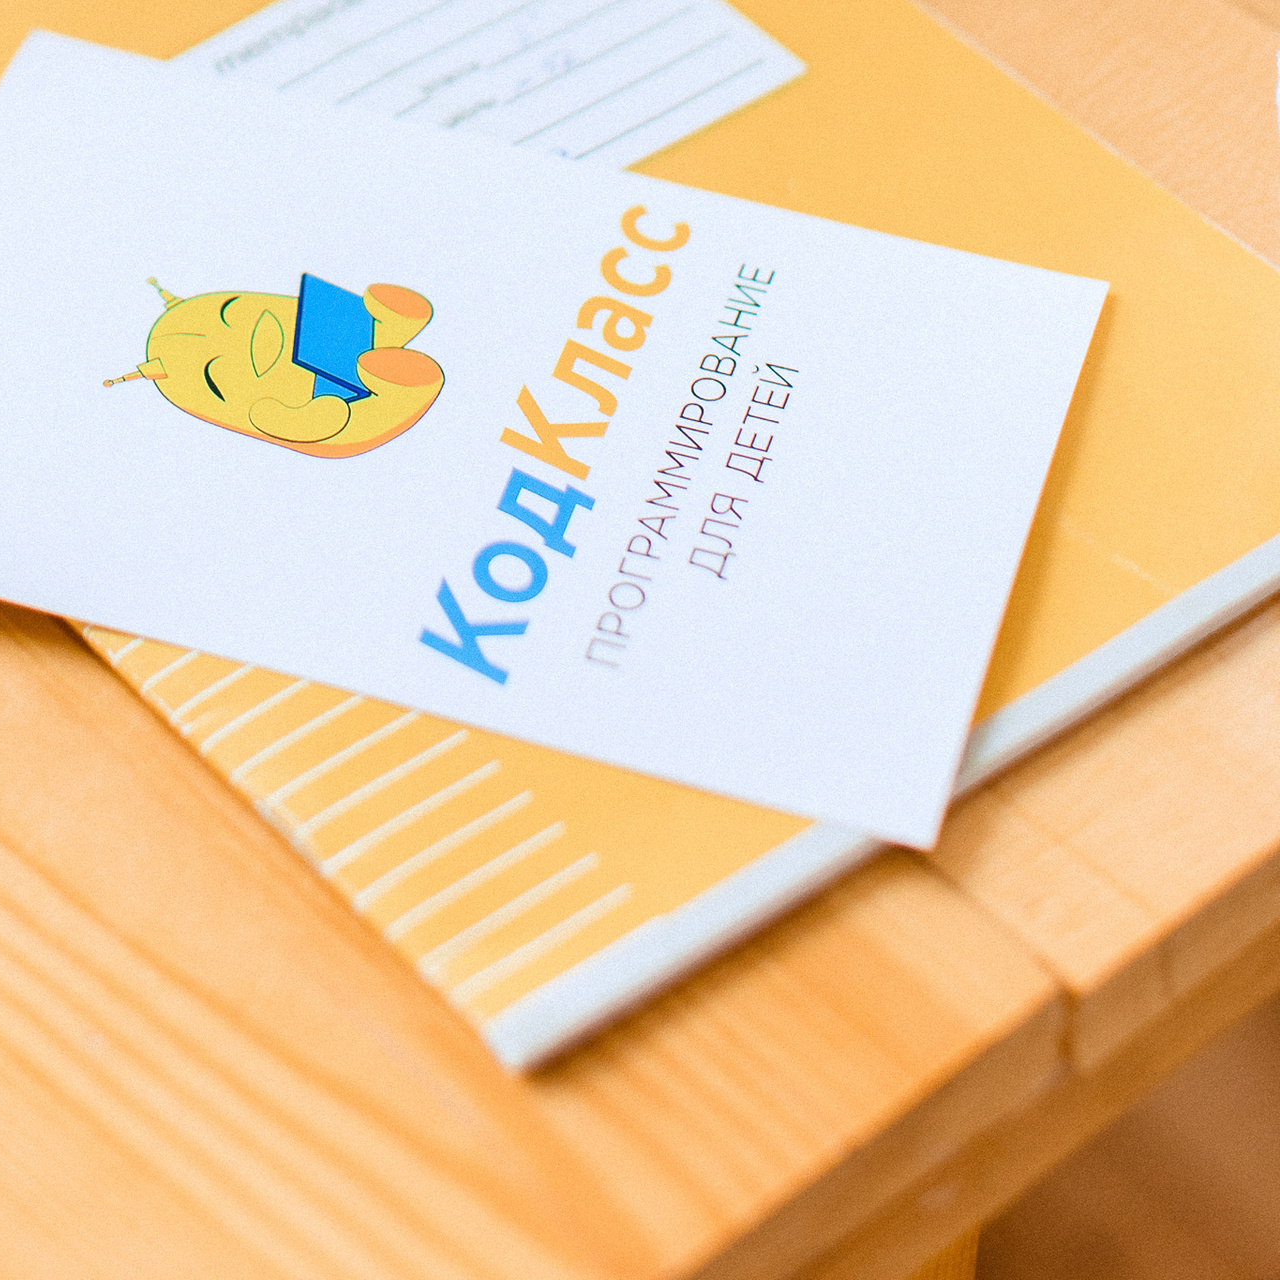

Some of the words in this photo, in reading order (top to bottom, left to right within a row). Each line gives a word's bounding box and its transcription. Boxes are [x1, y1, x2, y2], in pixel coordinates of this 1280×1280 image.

[418, 204, 692, 686] КодКласс
[584, 262, 776, 670] ПРОГРАММИРОВАНИЕ
[689, 491, 749, 580] ДЛЯ
[725, 361, 800, 484] ДЕТЕЙ
